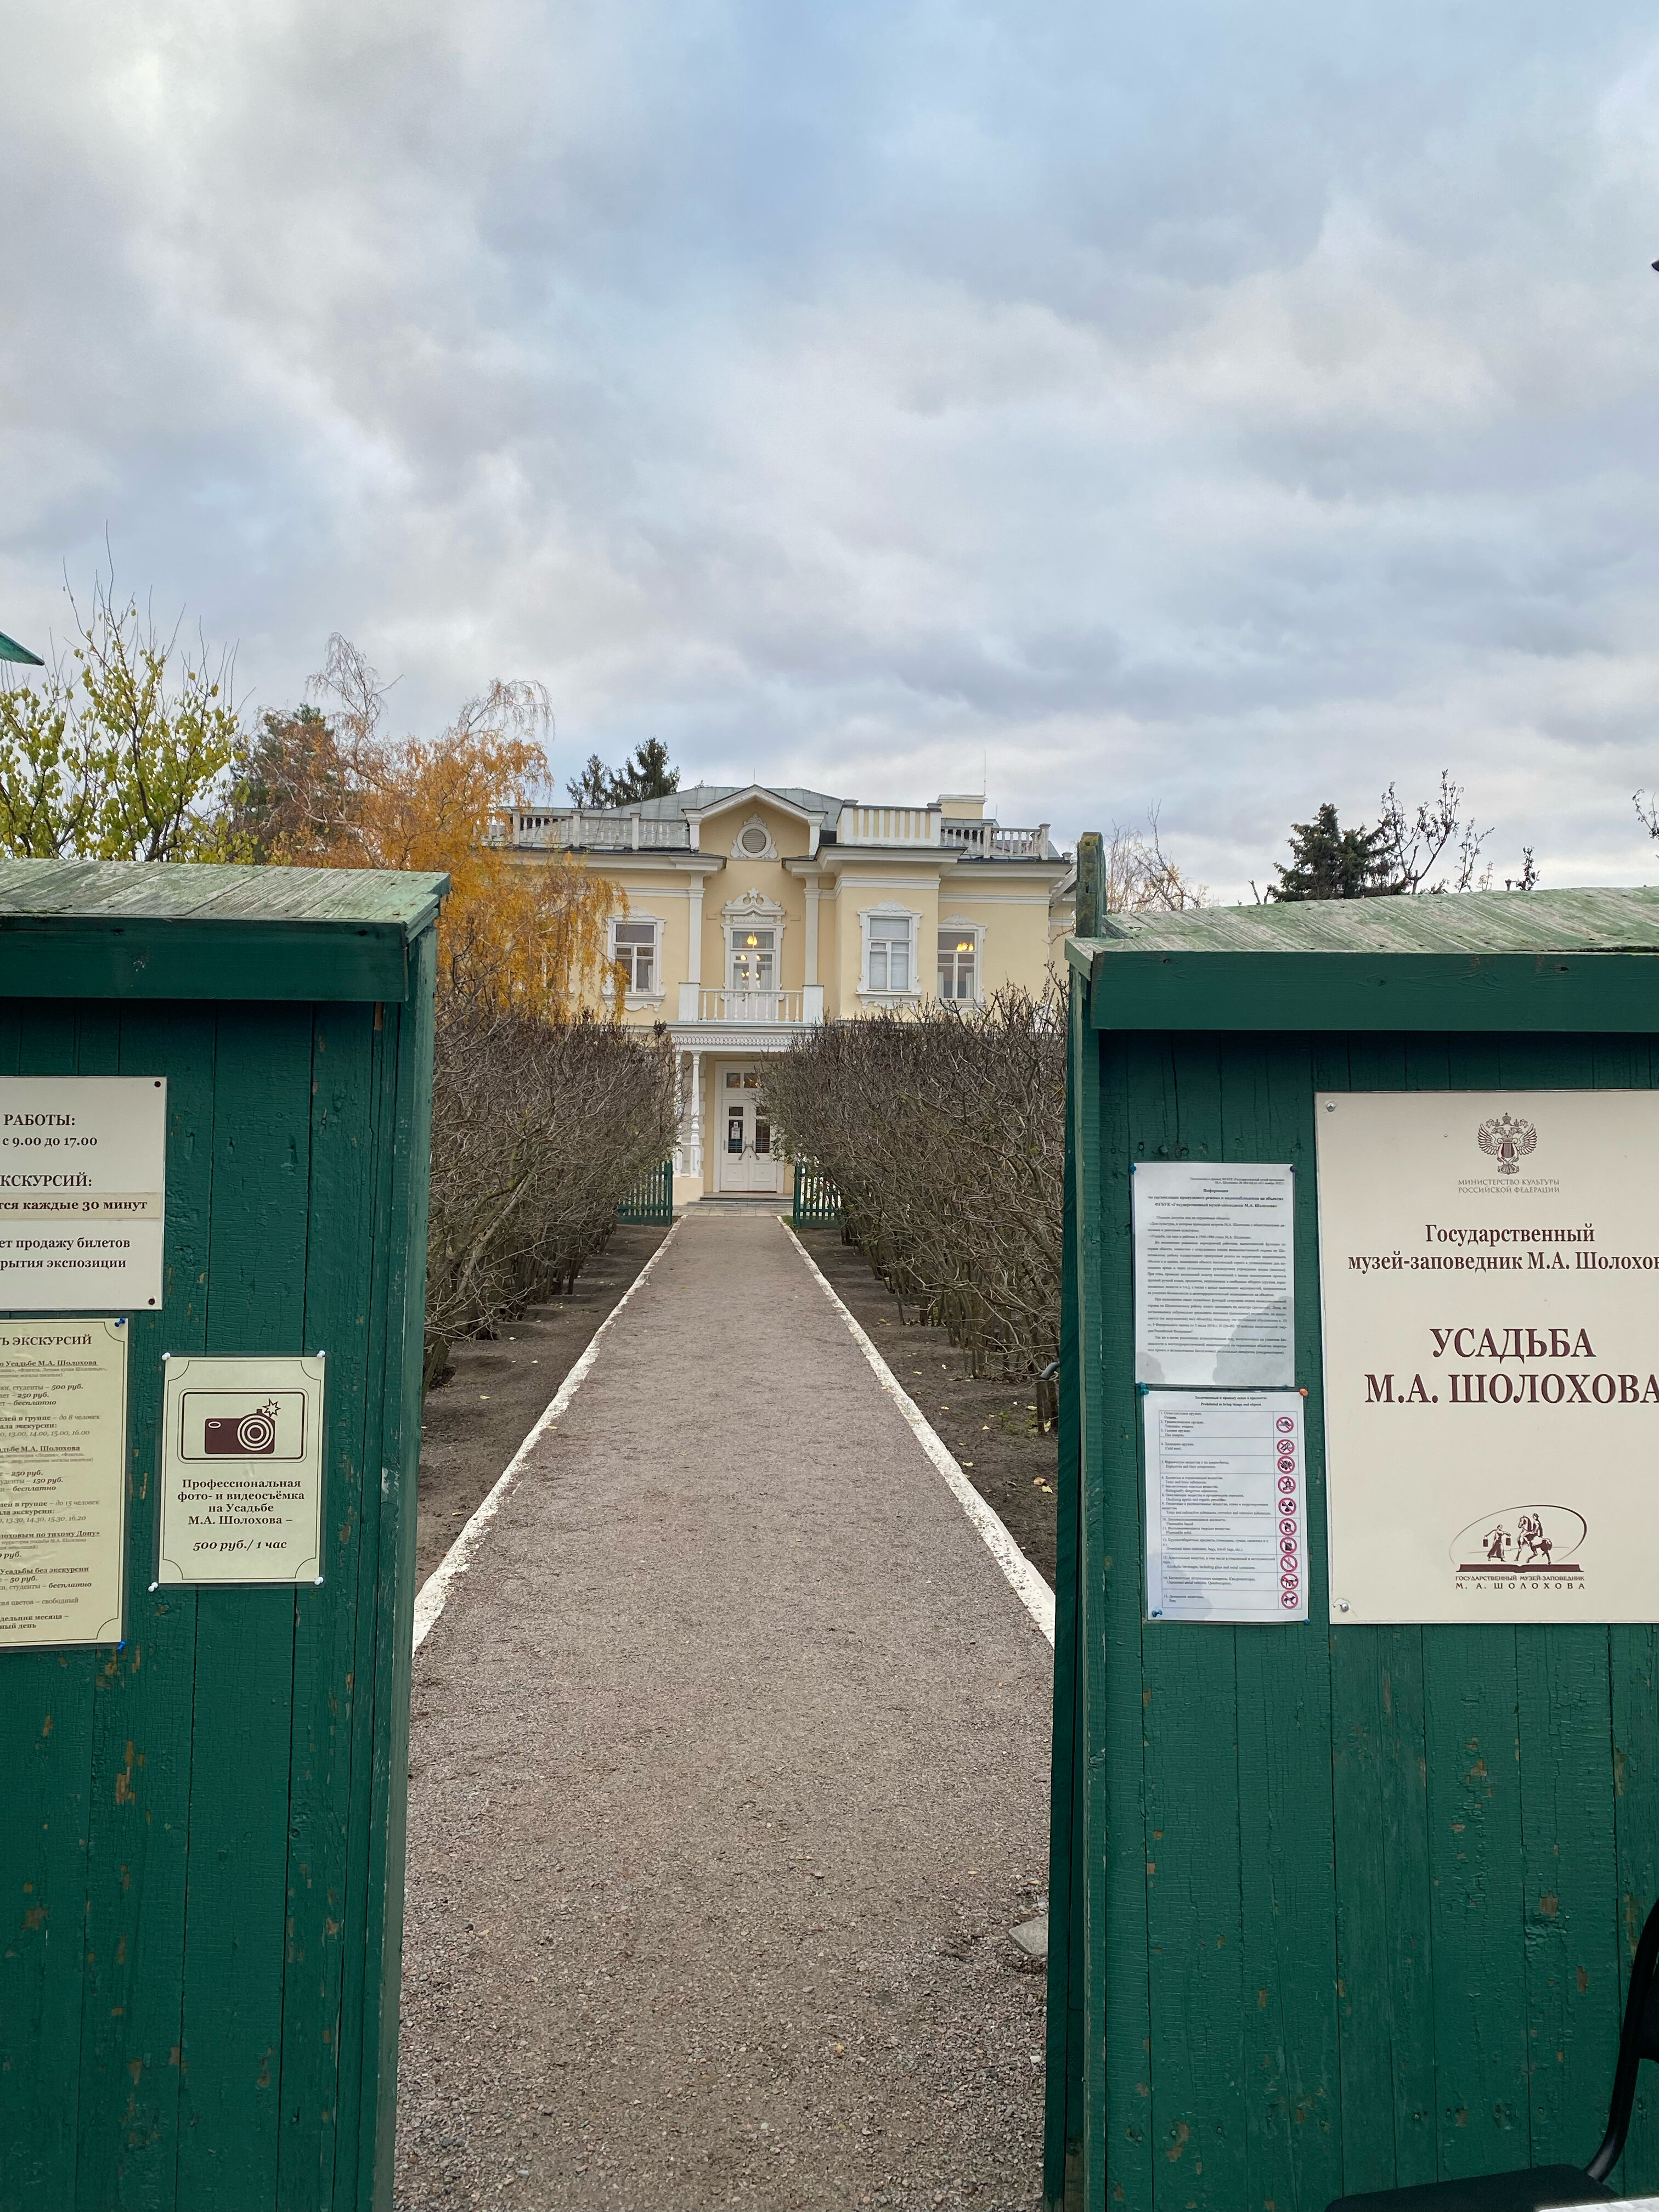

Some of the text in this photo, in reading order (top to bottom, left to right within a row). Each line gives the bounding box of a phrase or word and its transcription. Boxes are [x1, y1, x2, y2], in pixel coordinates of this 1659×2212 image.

[4, 1114, 76, 1126] РАБОТЫ:
[12, 1137, 41, 1148] 9.00
[44, 1137, 60, 1147] до
[63, 1137, 97, 1148] 17.00
[22, 1201, 78, 1211] каждые
[82, 1201, 99, 1211] 30
[103, 1201, 147, 1211] минут
[1425, 1223, 1595, 1246] Государственный
[15, 1239, 74, 1251] продажу
[76, 1237, 130, 1248] билетов
[0, 1259, 126, 1270] рытия экспозиции
[1348, 1250, 1522, 1274] музей-заповедник
[1527, 1252, 1570, 1269] М.А.
[13, 1334, 92, 1345] ЭКСКУРСИЙ
[1430, 1328, 1596, 1363] УСАДЬБА
[1365, 1374, 1659, 1403] М.А. ШОЛОХОВА
[182, 1479, 301, 1489] Профессиональная
[177, 1491, 212, 1503] фото-
[227, 1491, 304, 1502] видеосъёмка
[226, 1504, 274, 1514] Усадьбе
[188, 1515, 282, 1525] М.А. Шолохова
[193, 1542, 217, 1551] 500
[266, 1541, 287, 1549] час
